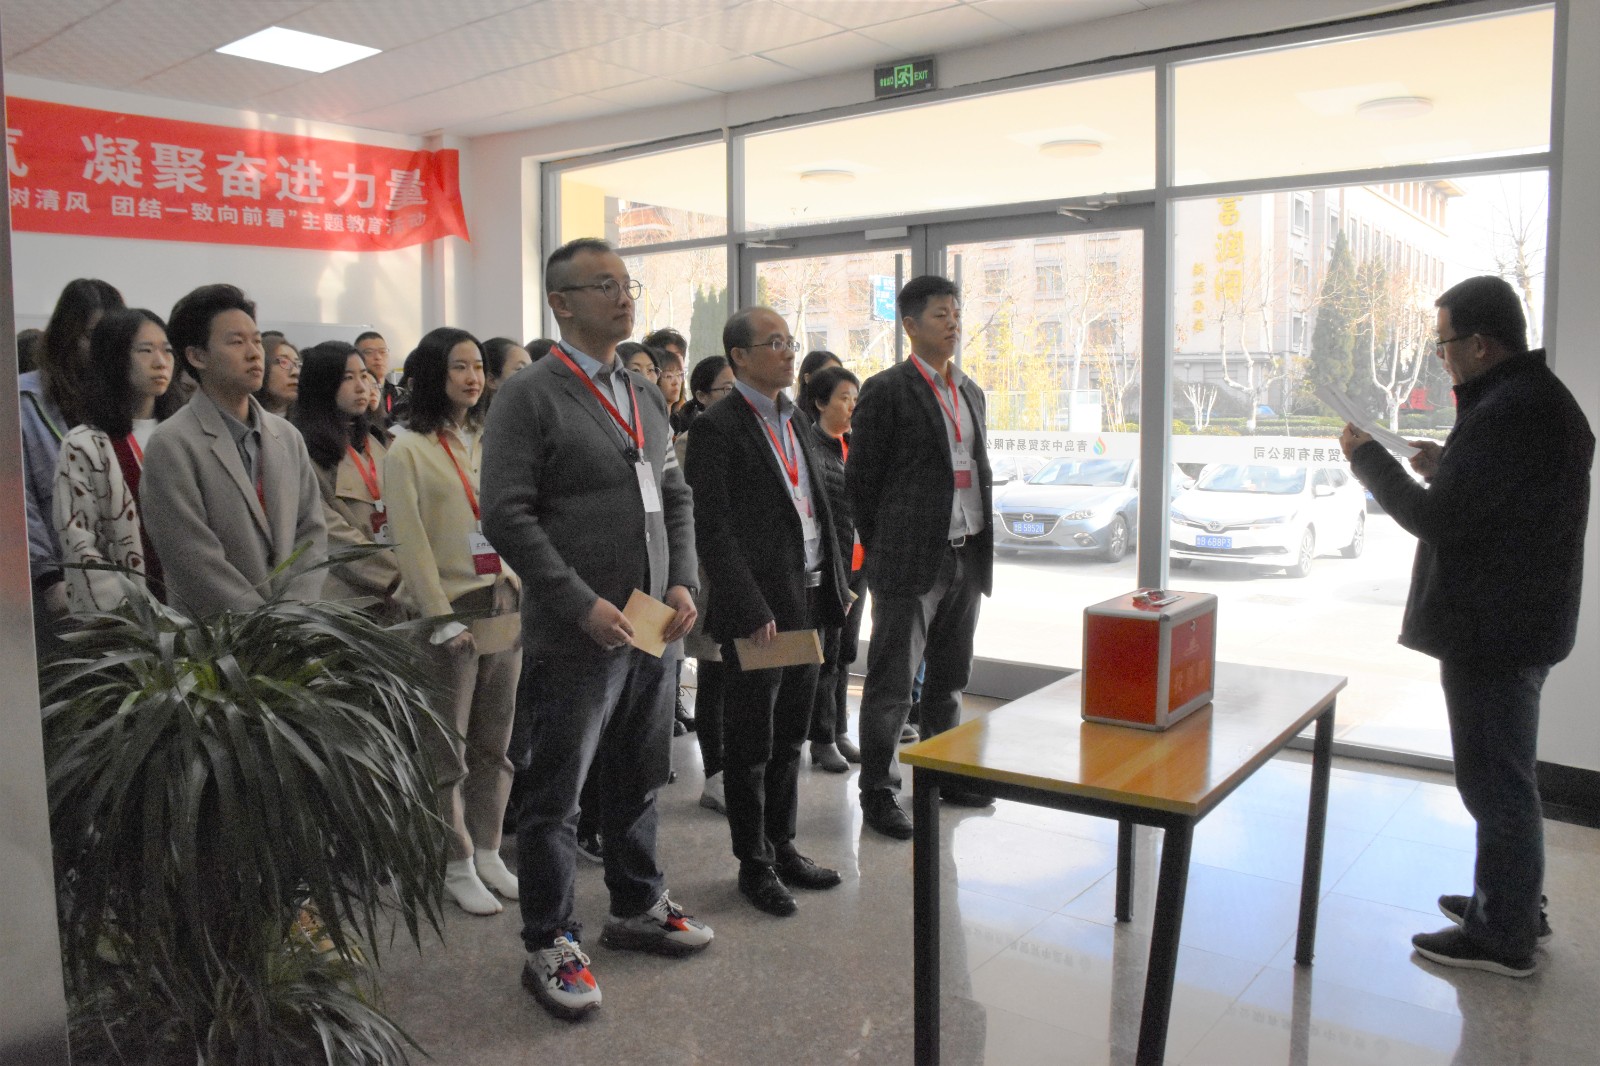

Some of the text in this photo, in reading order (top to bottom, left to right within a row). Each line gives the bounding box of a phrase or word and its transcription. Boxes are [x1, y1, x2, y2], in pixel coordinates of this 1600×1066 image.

[914, 70, 928, 81] EXIT
[81, 133, 428, 211] 凝聚奋进力量
